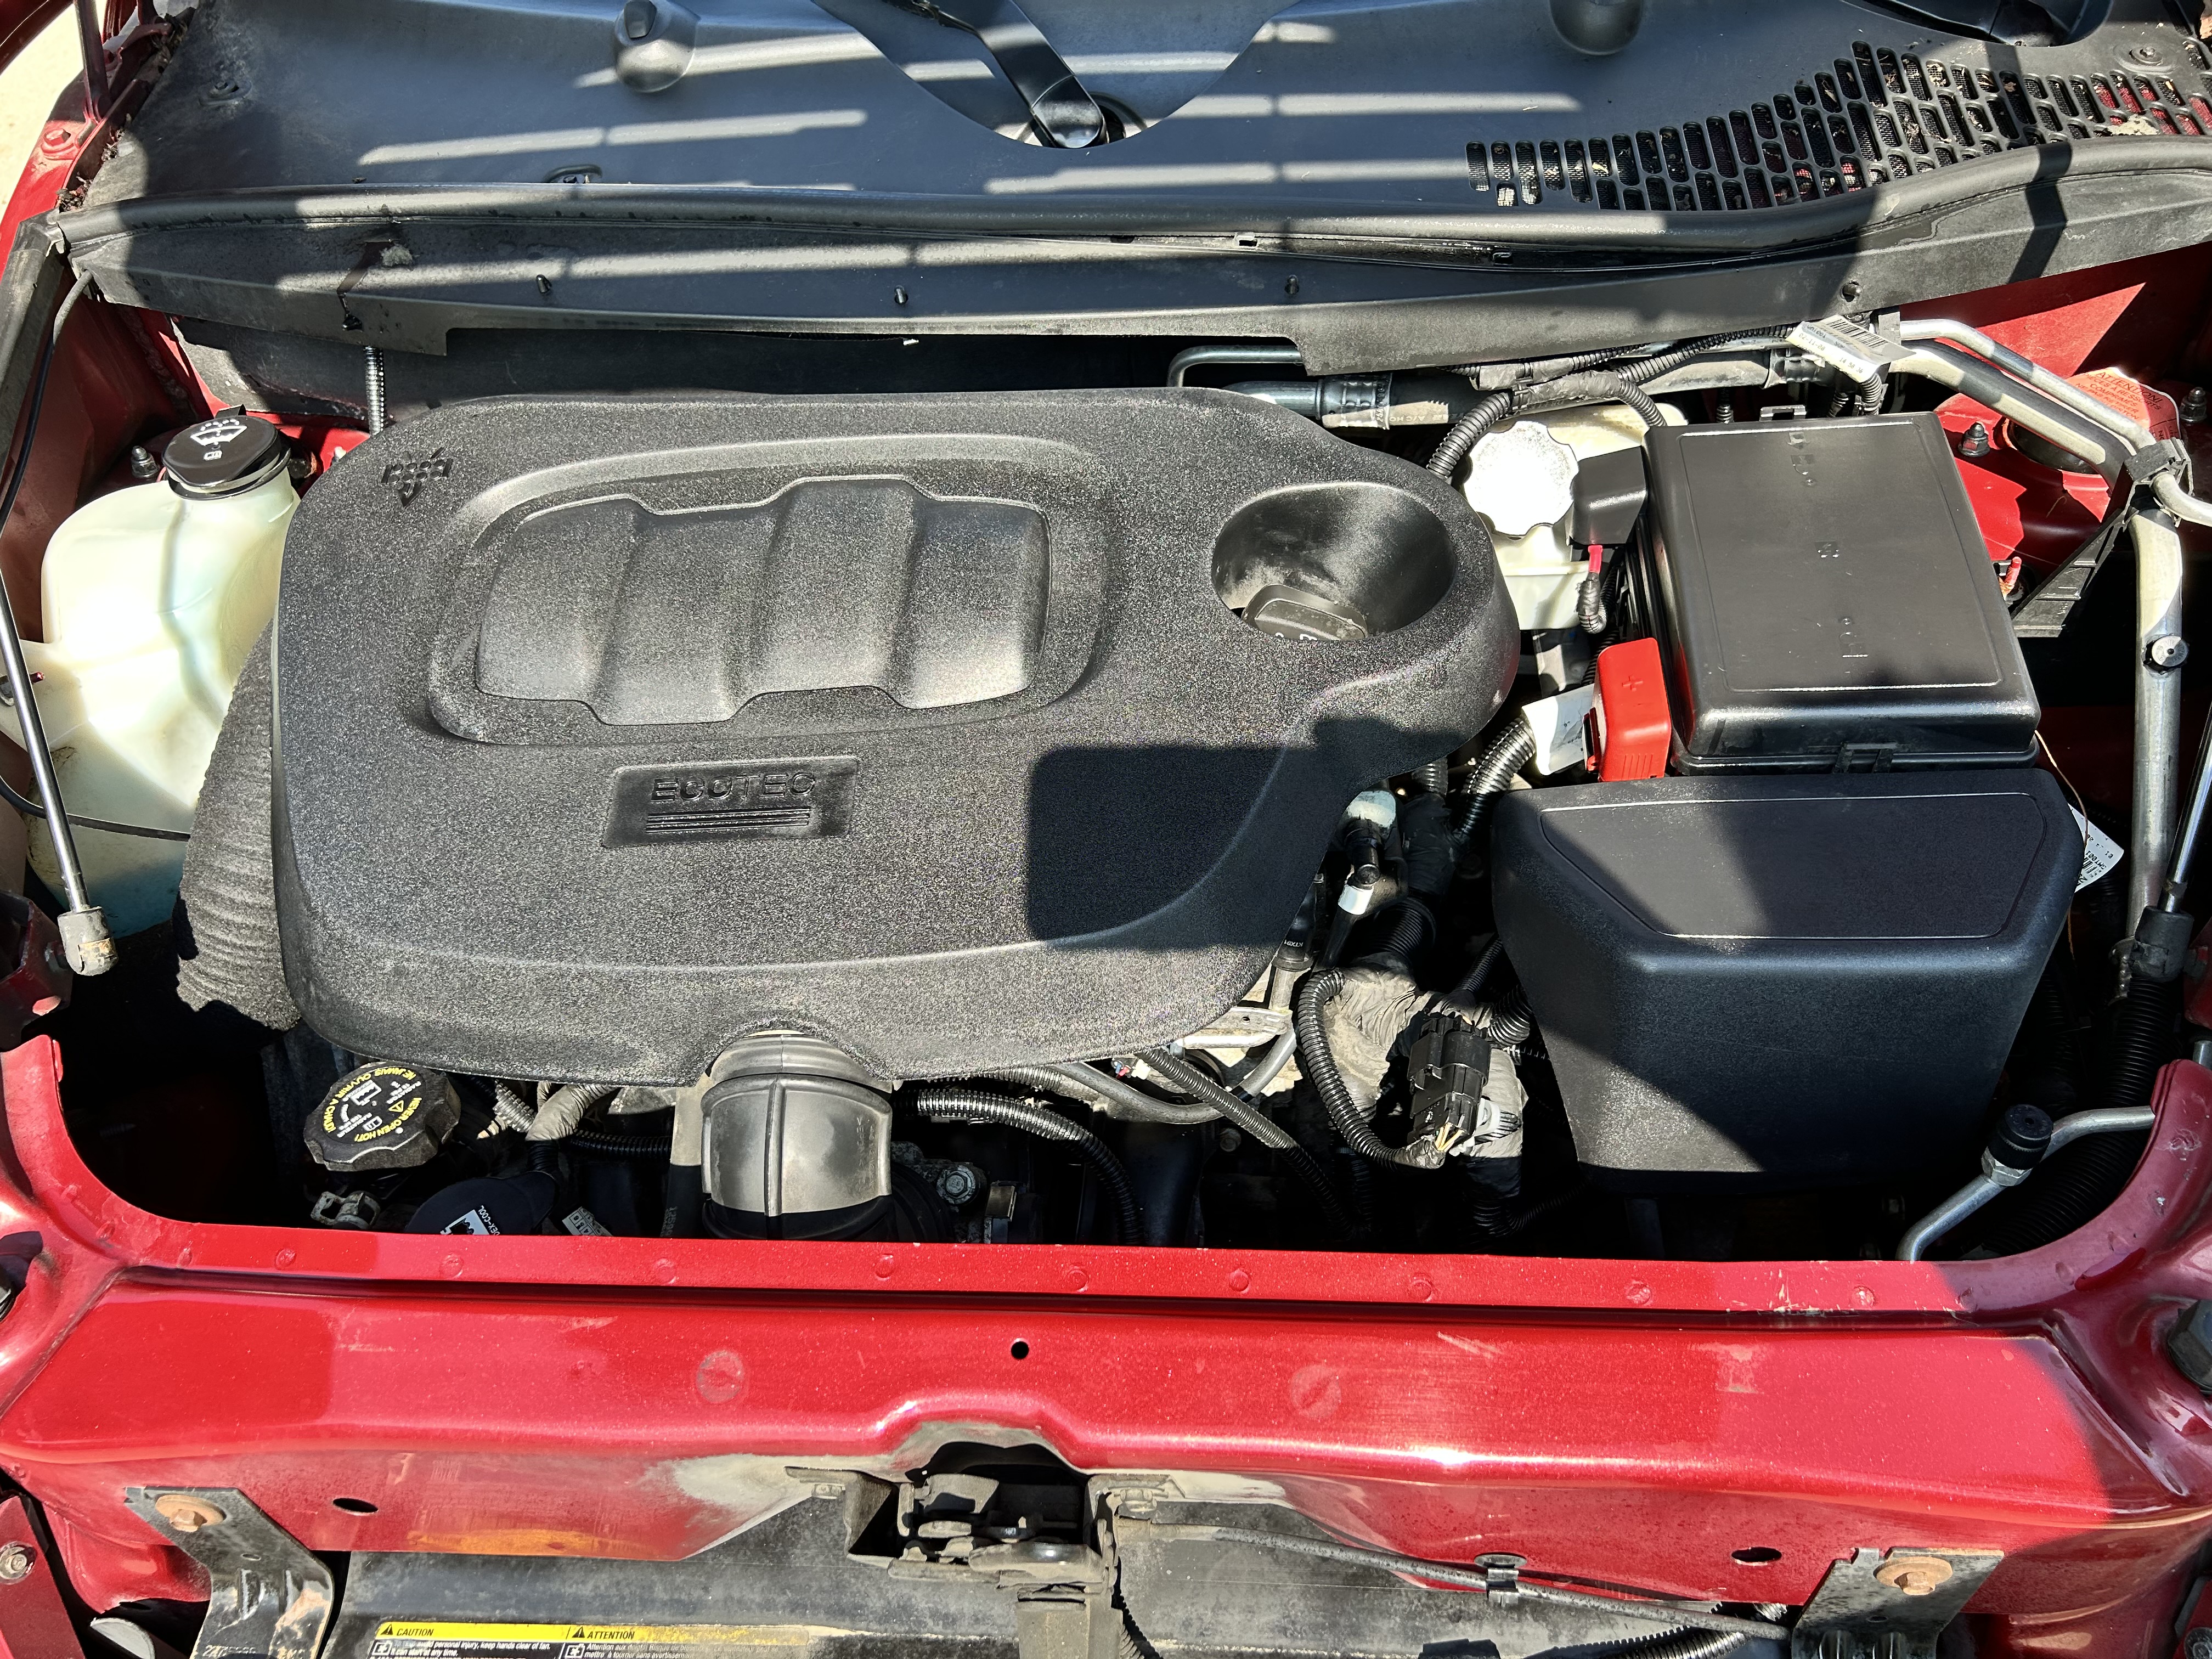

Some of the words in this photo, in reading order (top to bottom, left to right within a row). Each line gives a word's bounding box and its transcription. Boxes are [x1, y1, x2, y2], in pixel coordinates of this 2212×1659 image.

[651, 771, 816, 802] ECOTEC
[335, 1073, 372, 1098] OUVRIR
[398, 1097, 422, 1121] NEVER
[377, 1119, 402, 1136] OPEN
[354, 1131, 376, 1142] HOT!
[396, 1628, 434, 1637] CAUTION
[587, 1630, 635, 1640] ATTENTION
[480, 1642, 496, 1650] keep
